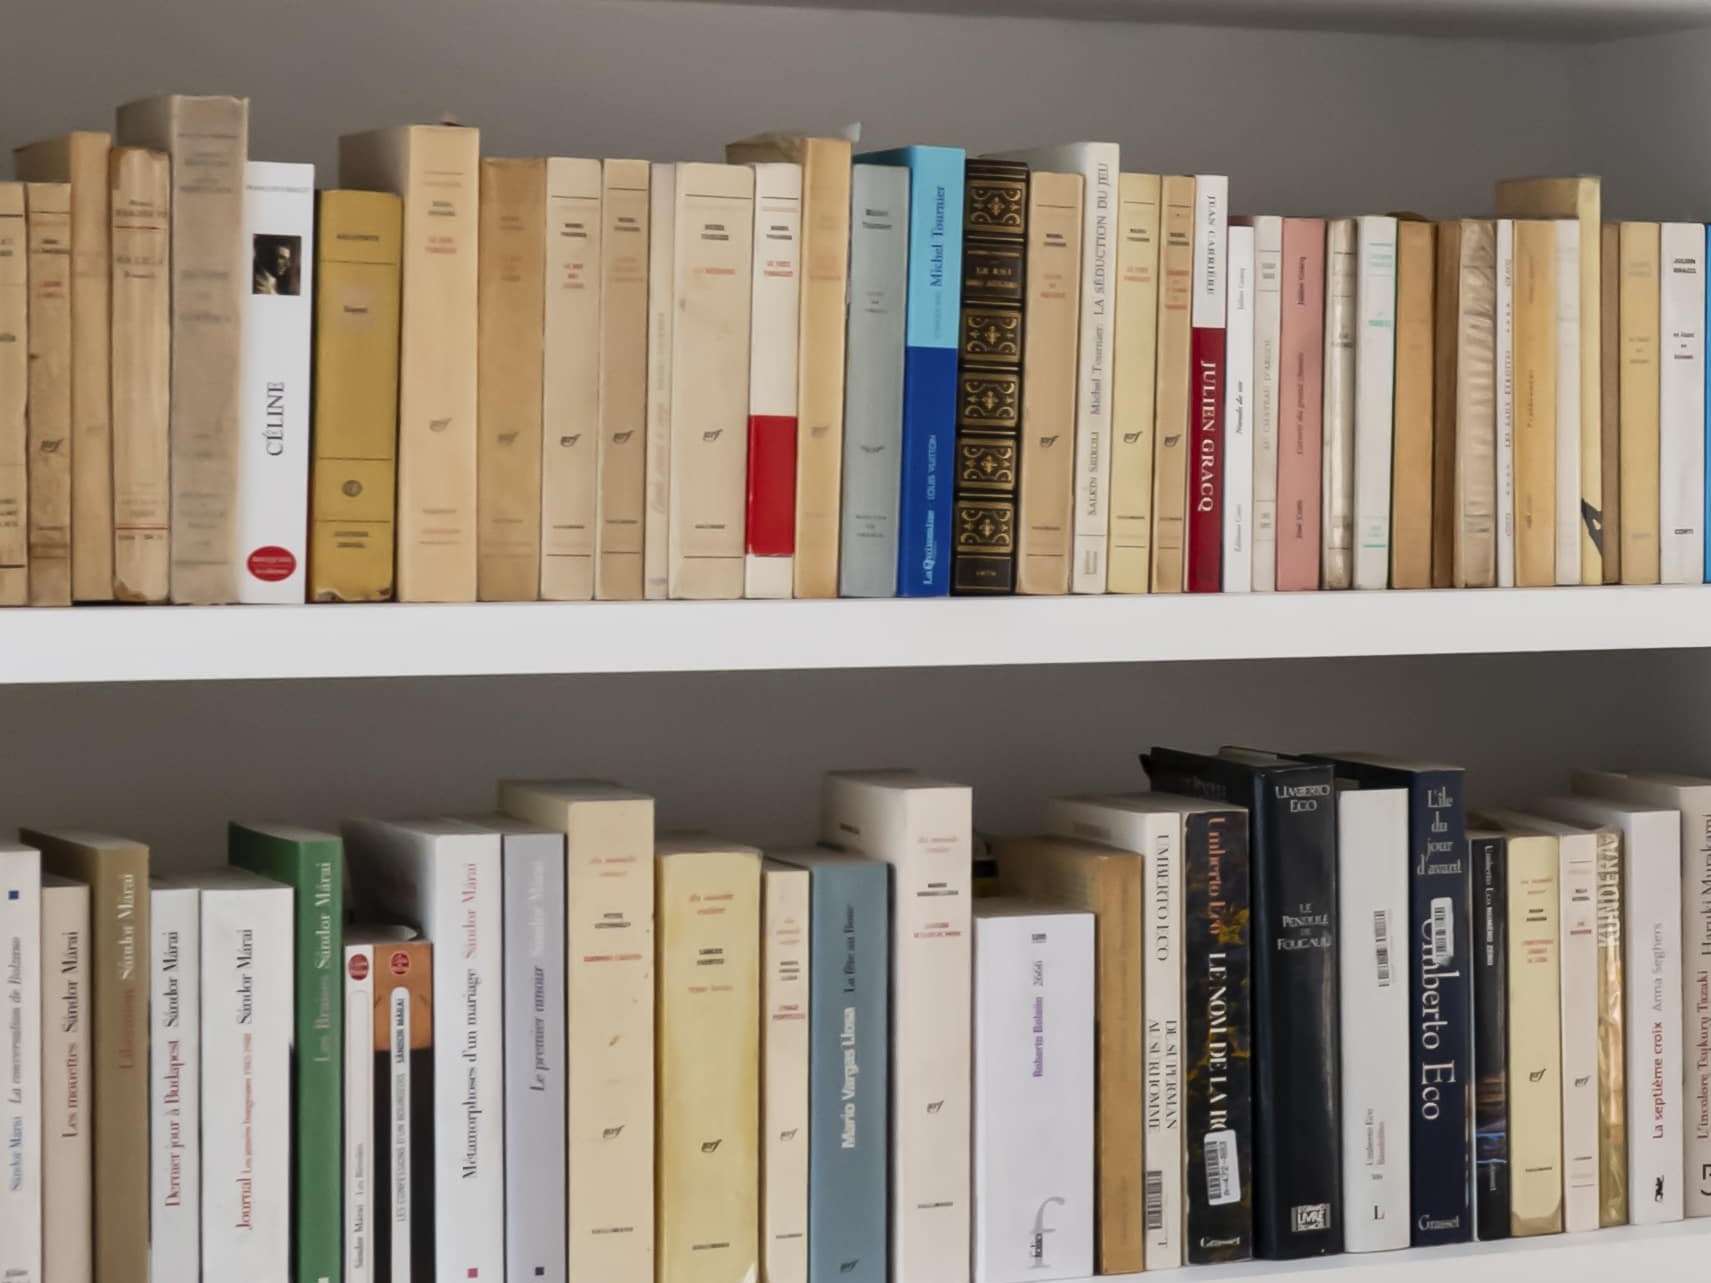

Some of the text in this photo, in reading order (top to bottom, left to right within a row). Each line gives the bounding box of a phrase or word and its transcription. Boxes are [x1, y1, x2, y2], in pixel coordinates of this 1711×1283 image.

[932, 185, 946, 287] Michel Tournier
[263, 381, 286, 457] CÉLINE
[1197, 359, 1216, 513] JULIEN GRACQ
[841, 1006, 860, 1150] Mario Vargas Llosa
[234, 1177, 253, 1232] Journal
